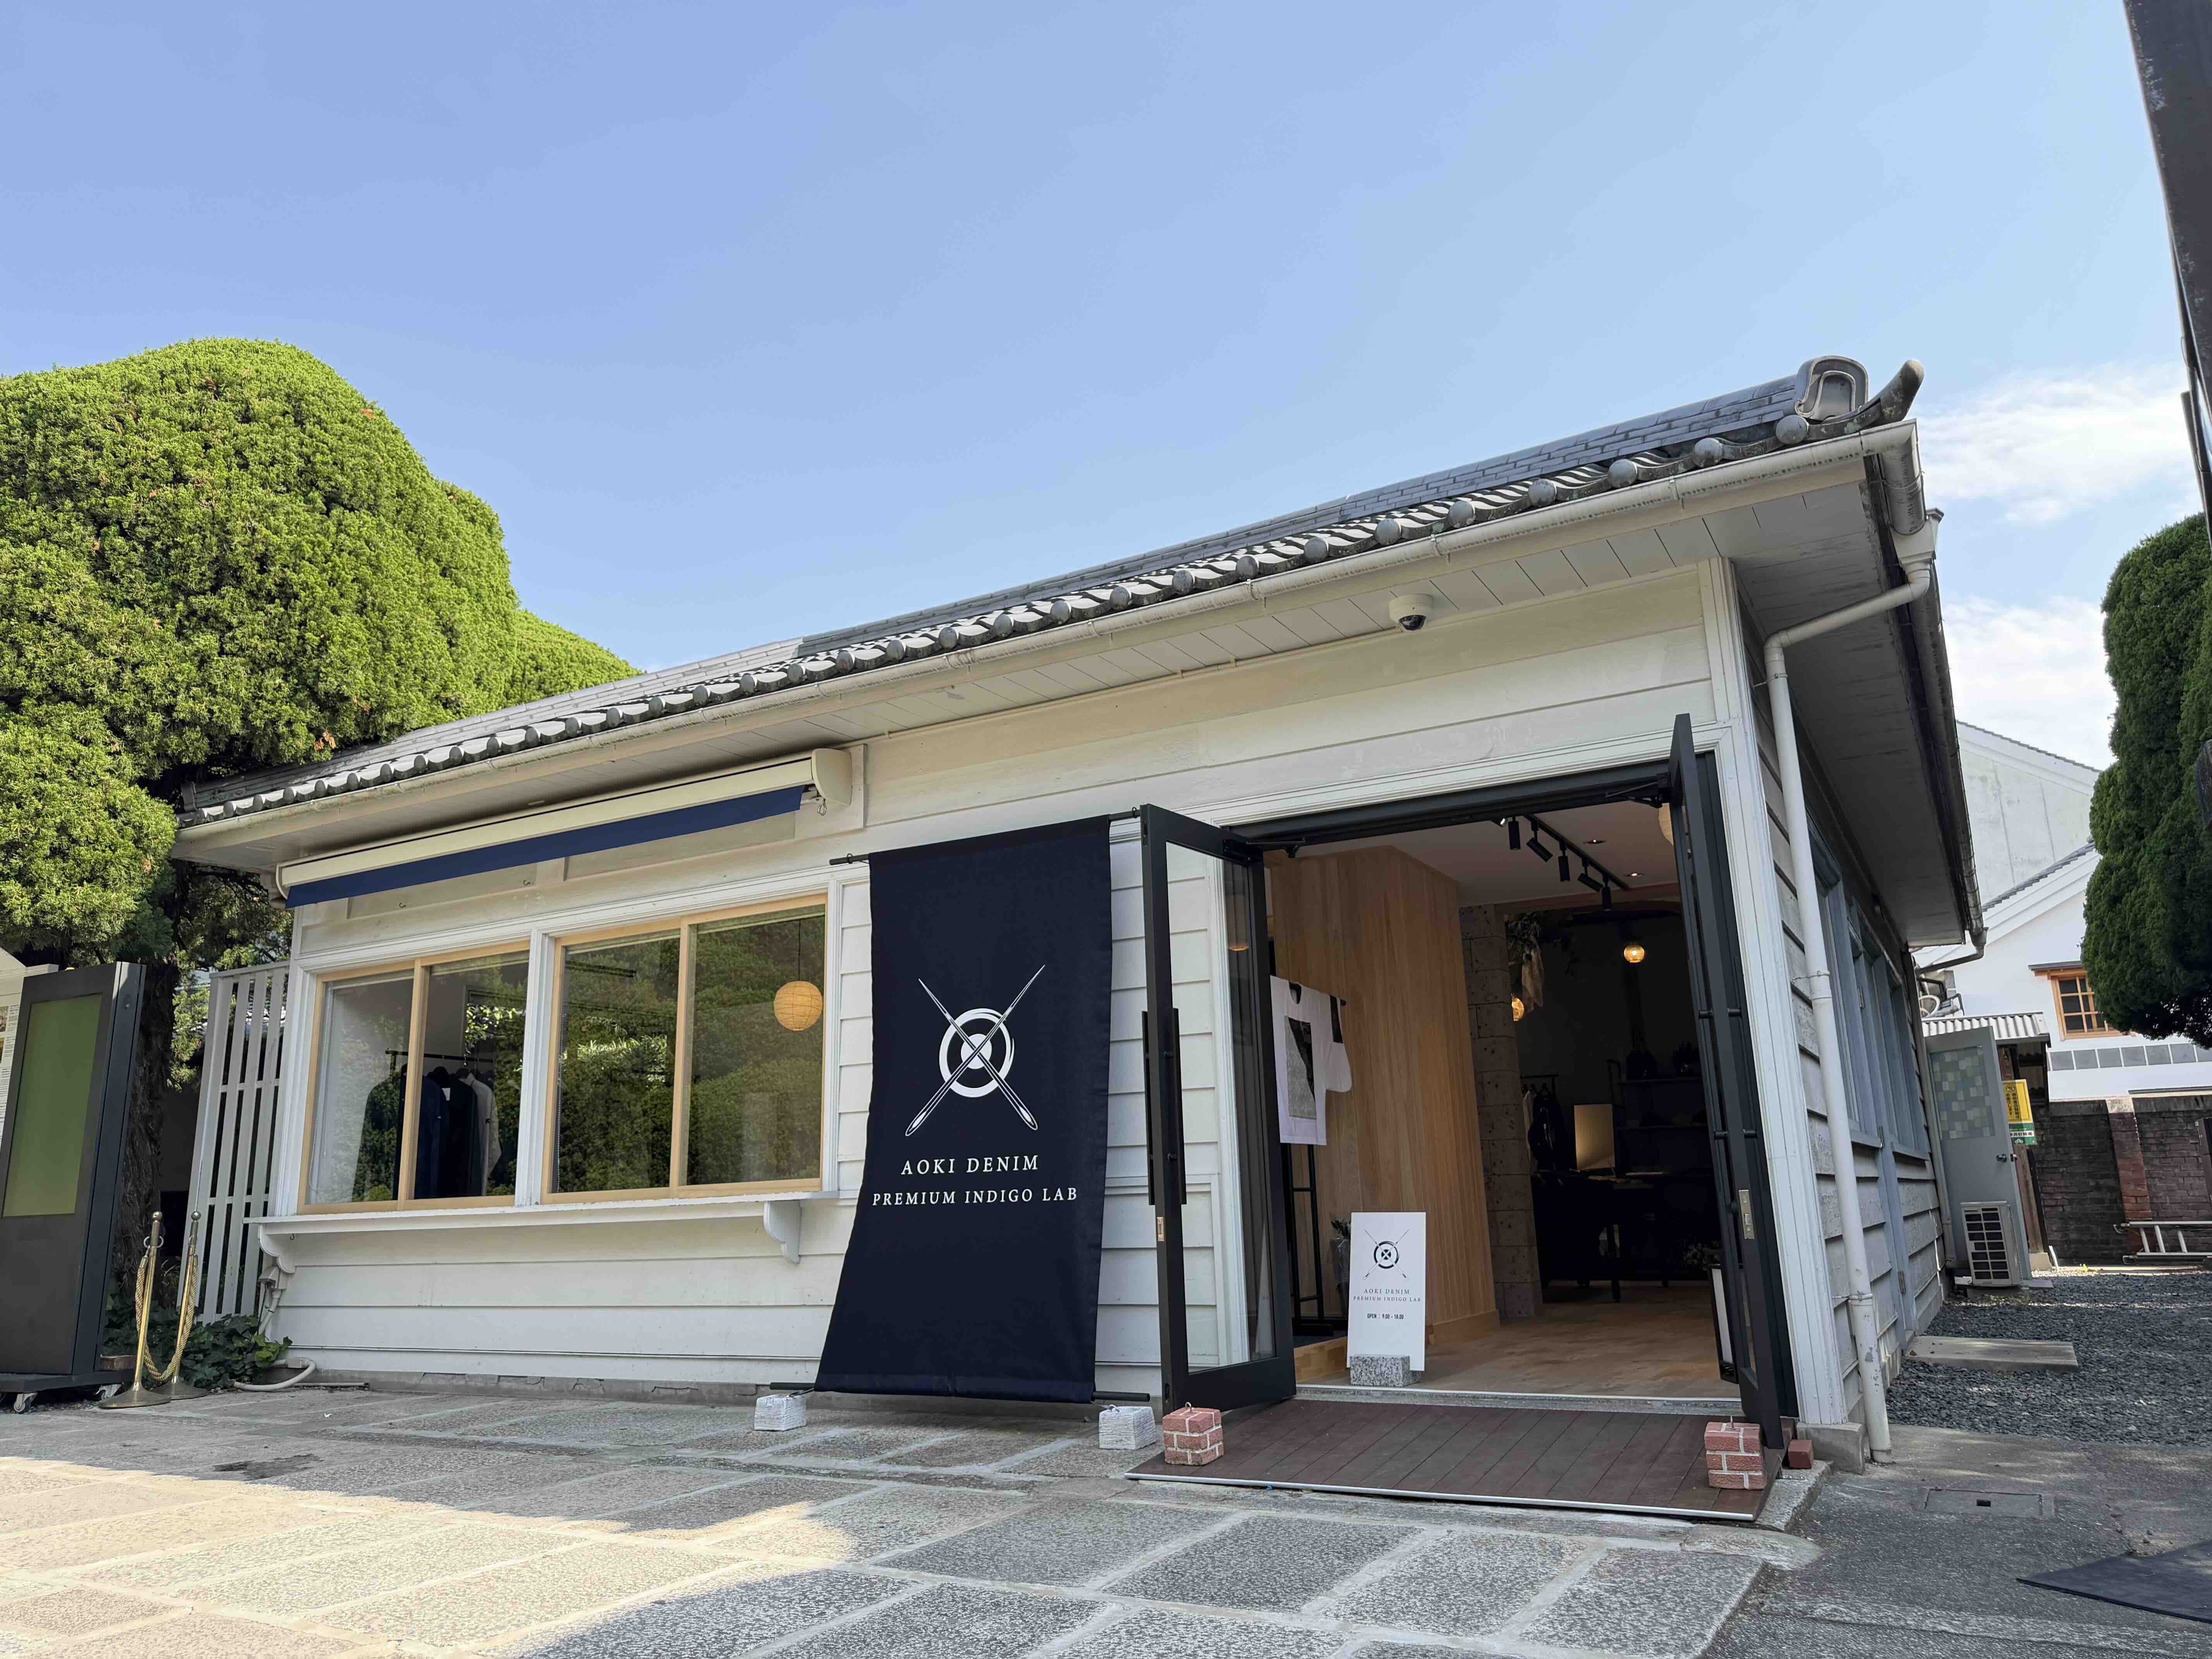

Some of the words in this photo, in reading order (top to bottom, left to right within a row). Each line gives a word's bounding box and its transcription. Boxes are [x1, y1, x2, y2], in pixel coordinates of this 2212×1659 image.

[900, 1158, 955, 1175] AOKI
[966, 1155, 1039, 1173] DENIM
[872, 1190, 956, 1206] PREMIUM
[964, 1188, 1033, 1204] INDIGO
[1042, 1187, 1077, 1201] LAB
